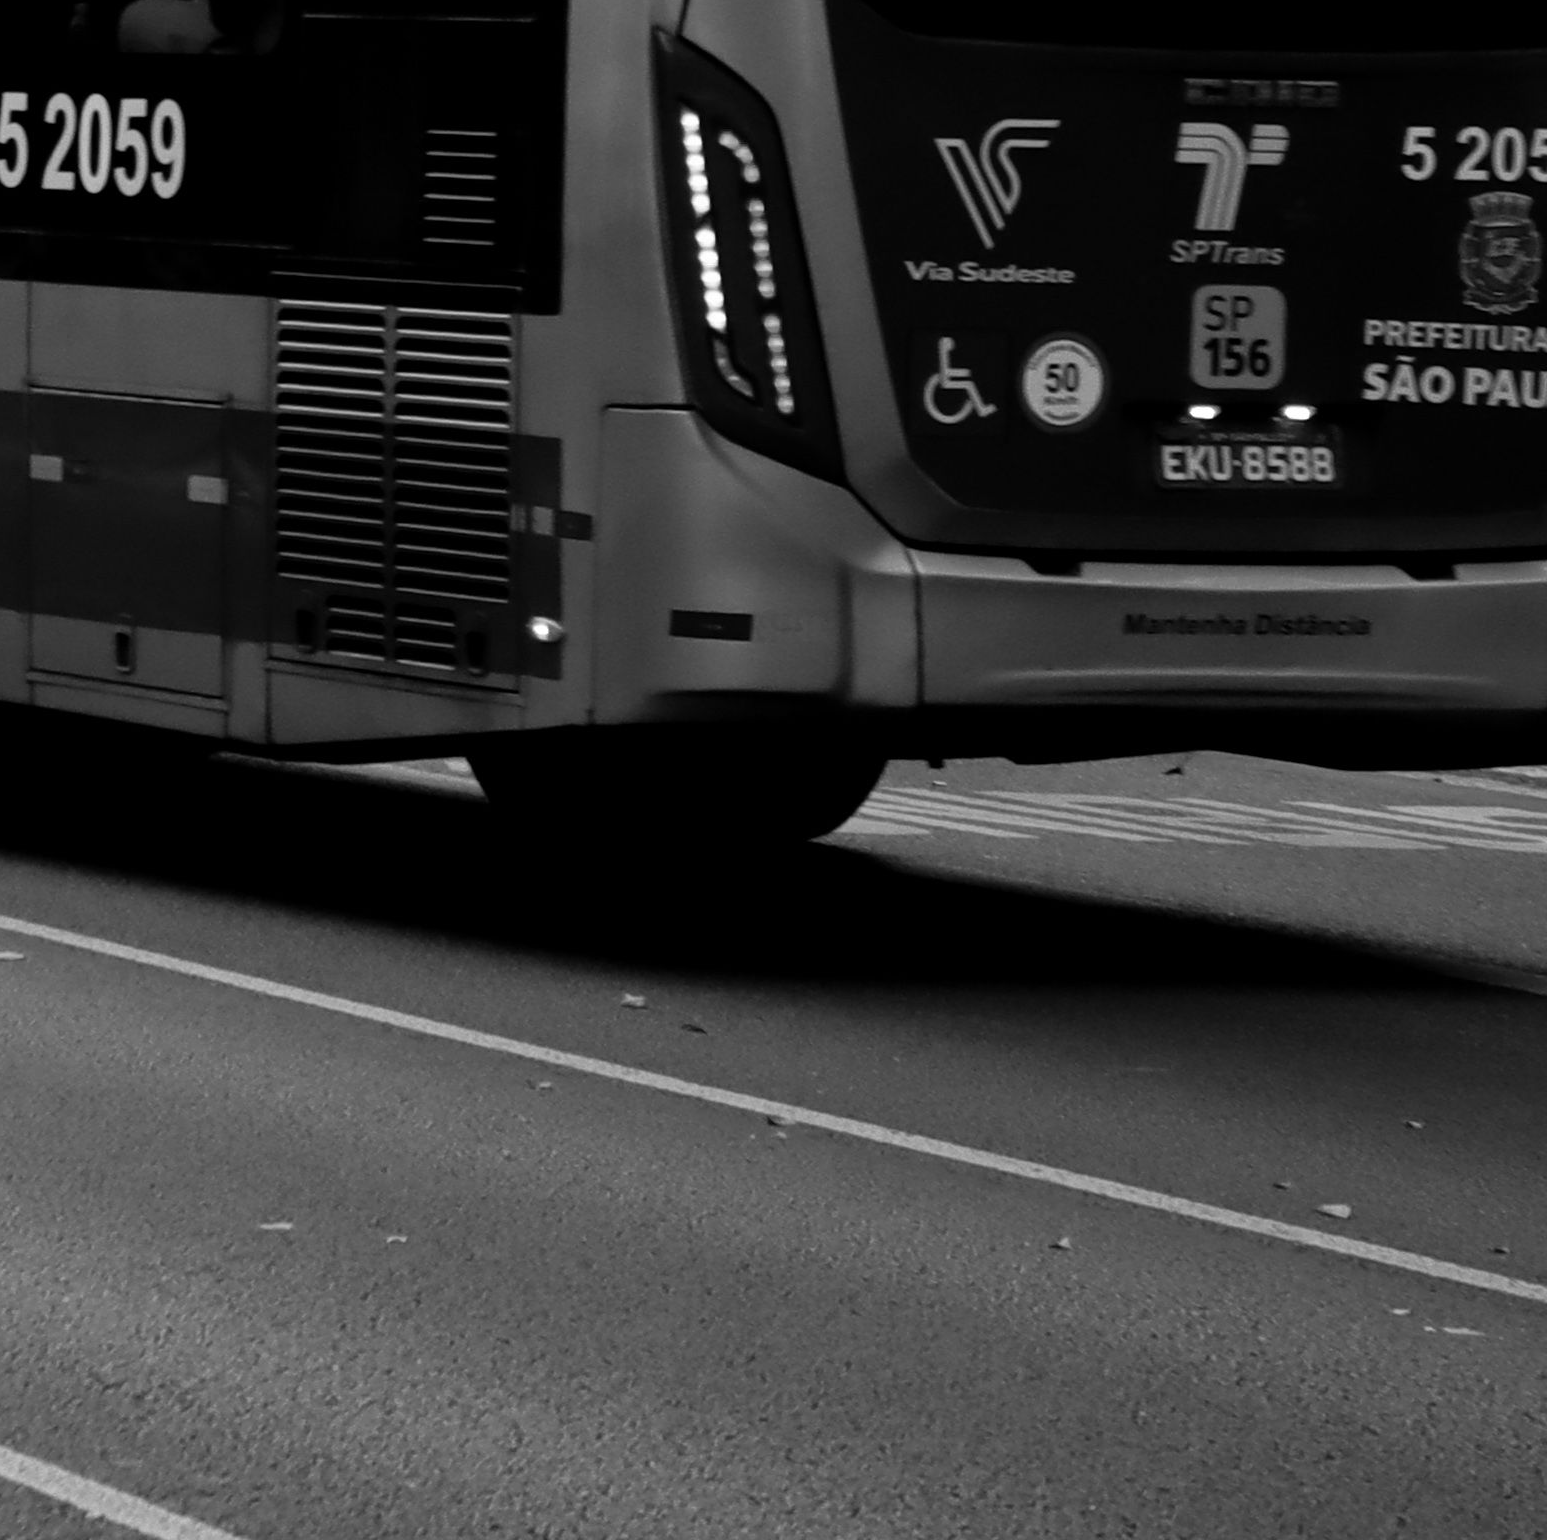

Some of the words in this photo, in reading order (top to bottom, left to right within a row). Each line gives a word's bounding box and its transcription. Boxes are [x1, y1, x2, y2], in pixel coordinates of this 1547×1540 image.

[42, 92, 187, 199] 2059
[1399, 126, 1438, 181] 5
[1169, 238, 1286, 266] SPTrans
[903, 260, 954, 282] Via
[958, 261, 1076, 284] Sudeste
[1203, 294, 1255, 334] SP
[1362, 318, 1547, 353] PREFEITURA
[1204, 337, 1271, 378] 156
[1044, 362, 1081, 393] 50
[1360, 355, 1455, 404] SÃO
[1121, 613, 1247, 636] Mantenha
[1252, 611, 1372, 637] Distância
